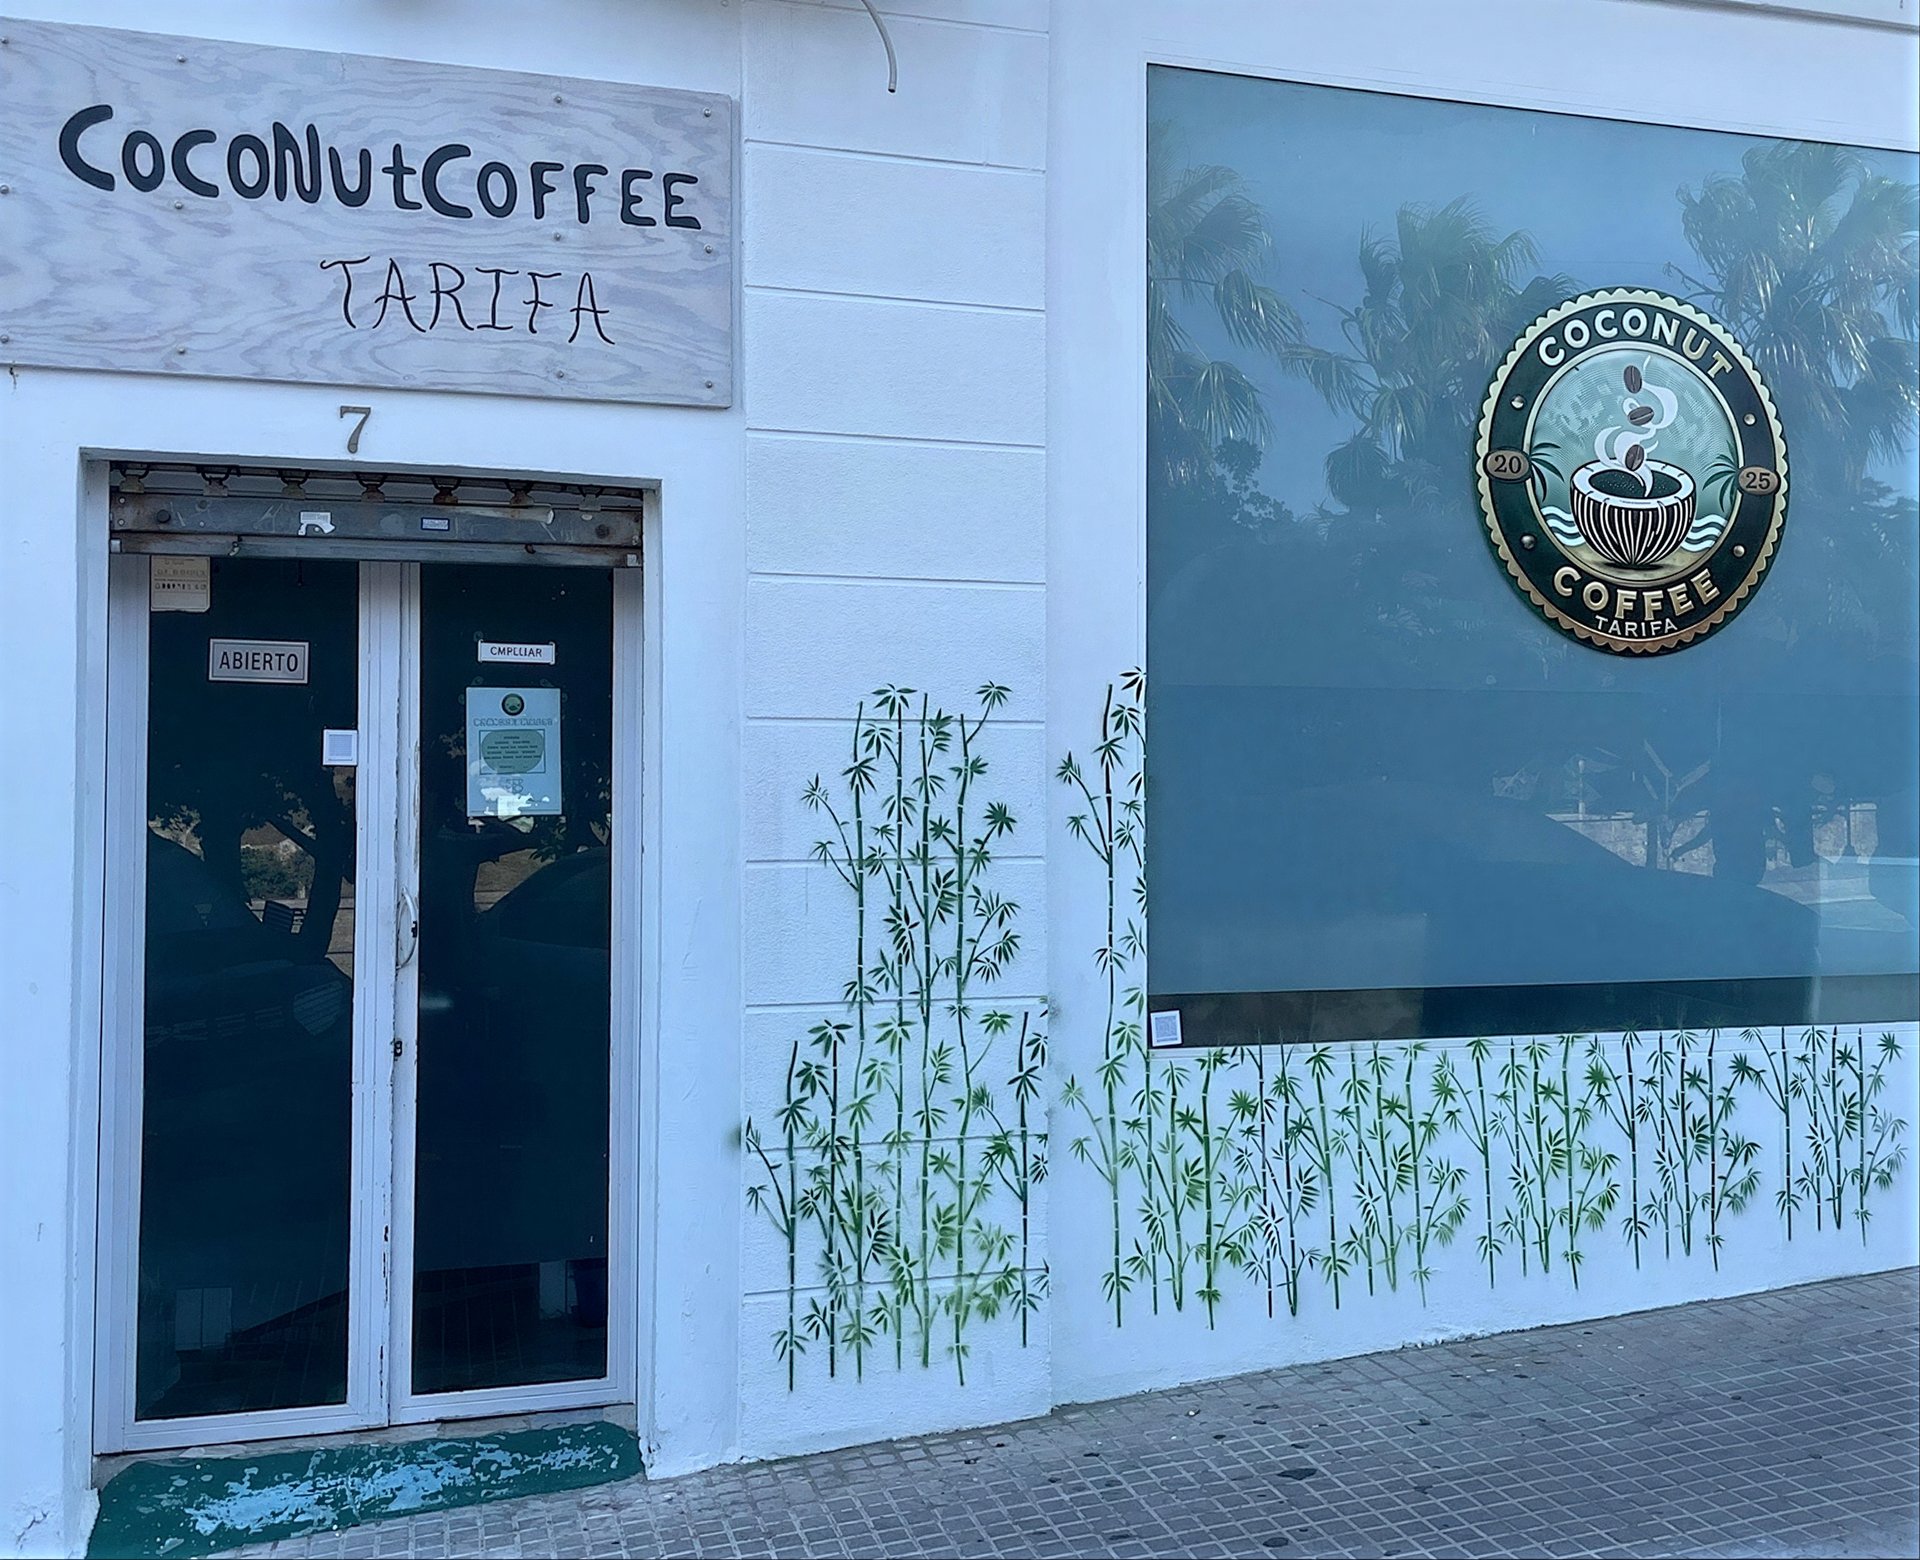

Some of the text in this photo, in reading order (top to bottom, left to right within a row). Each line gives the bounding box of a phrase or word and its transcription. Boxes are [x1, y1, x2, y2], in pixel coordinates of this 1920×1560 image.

[319, 255, 616, 346] TARIFA
[1537, 308, 1734, 379] COCONUT
[338, 405, 372, 455] 7
[1493, 453, 1522, 475] 20
[1745, 471, 1771, 490] 25
[1553, 565, 1721, 621] COFFEE
[1594, 614, 1678, 638] TARIFA
[218, 650, 299, 672] ABIERTO
